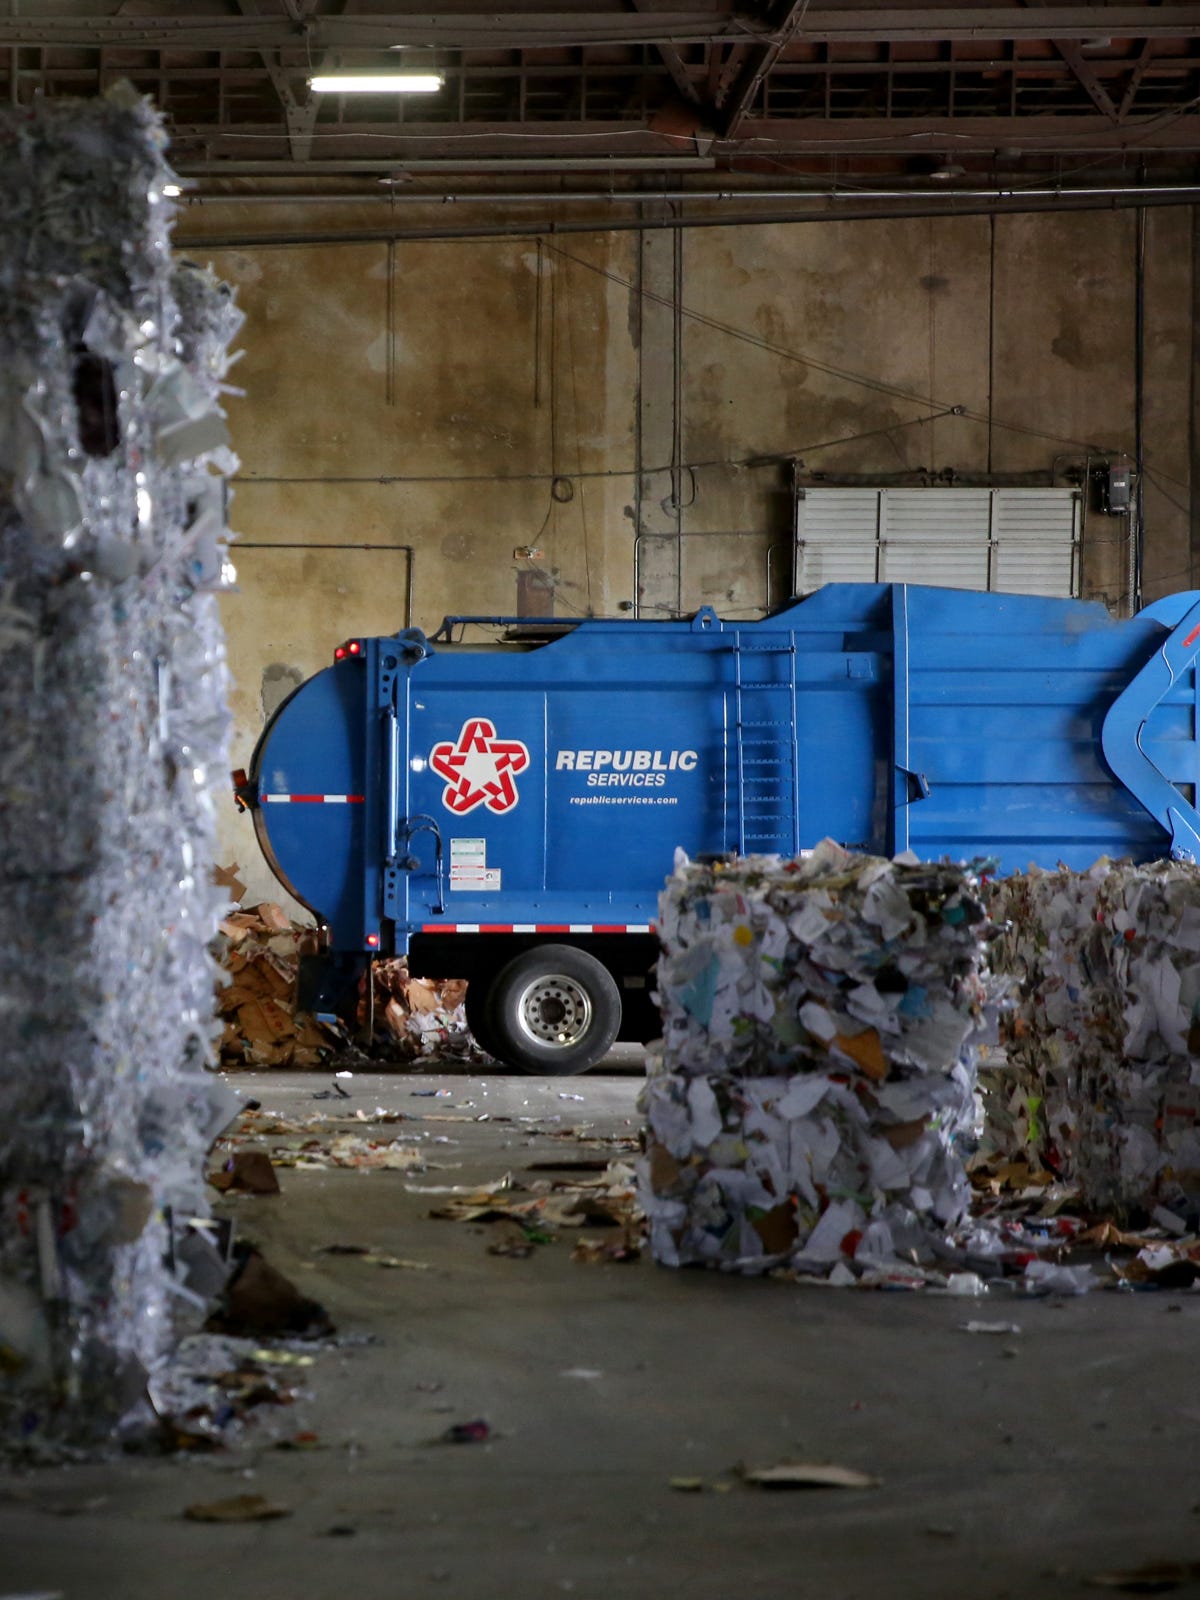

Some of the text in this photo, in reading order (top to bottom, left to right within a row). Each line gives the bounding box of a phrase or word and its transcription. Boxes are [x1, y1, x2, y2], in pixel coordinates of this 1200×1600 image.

[555, 750, 698, 771] REPUBLIC
[586, 773, 666, 787] SERVICES
[569, 795, 678, 805] republicservices.com
